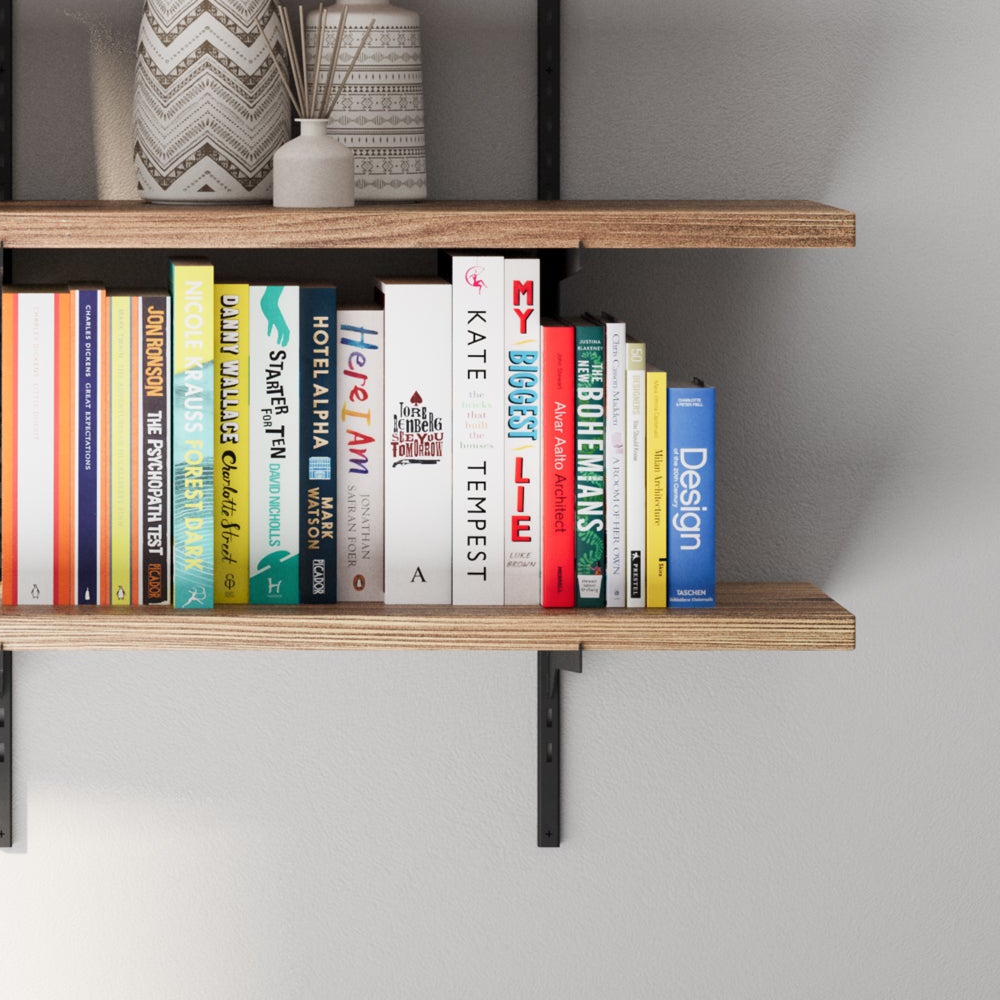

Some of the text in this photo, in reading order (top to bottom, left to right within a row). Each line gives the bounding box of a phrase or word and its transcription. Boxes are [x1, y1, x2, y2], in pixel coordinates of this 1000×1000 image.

[220, 295, 239, 444] DANNY WALLACE
[312, 316, 329, 449] HOTEL ALPHA
[467, 310, 487, 379] KATE
[577, 360, 589, 384] NEW
[591, 363, 604, 384] THE
[631, 348, 642, 363] 50
[144, 306, 165, 556] JON RONSON THE PSYCHOPATH TEST
[184, 281, 203, 570] NICOLE KRAUSS FOREST DARK
[261, 350, 289, 459] STARTER FOR TEN
[340, 324, 379, 475] Here I Am
[508, 280, 539, 542] MY BIGGEST LIE
[554, 401, 567, 533] Alvar Aalto Architect
[577, 387, 604, 532] BOHEMIANS
[654, 449, 663, 473] Milan
[654, 475, 663, 527] Architecture
[671, 483, 680, 508] Century
[672, 447, 708, 550] Design
[220, 450, 240, 564] Charlotte Street
[269, 464, 281, 547] DAVID NICHOLLS
[307, 487, 321, 550] WATSON
[321, 497, 333, 540] MARK
[347, 485, 357, 568] SAFRAN FOER
[360, 494, 370, 560] JONATHAN
[467, 461, 487, 581] TEMPEST
[613, 504, 620, 520] OF
[147, 563, 162, 599] PICADOR
[312, 558, 325, 595] PICADOR
